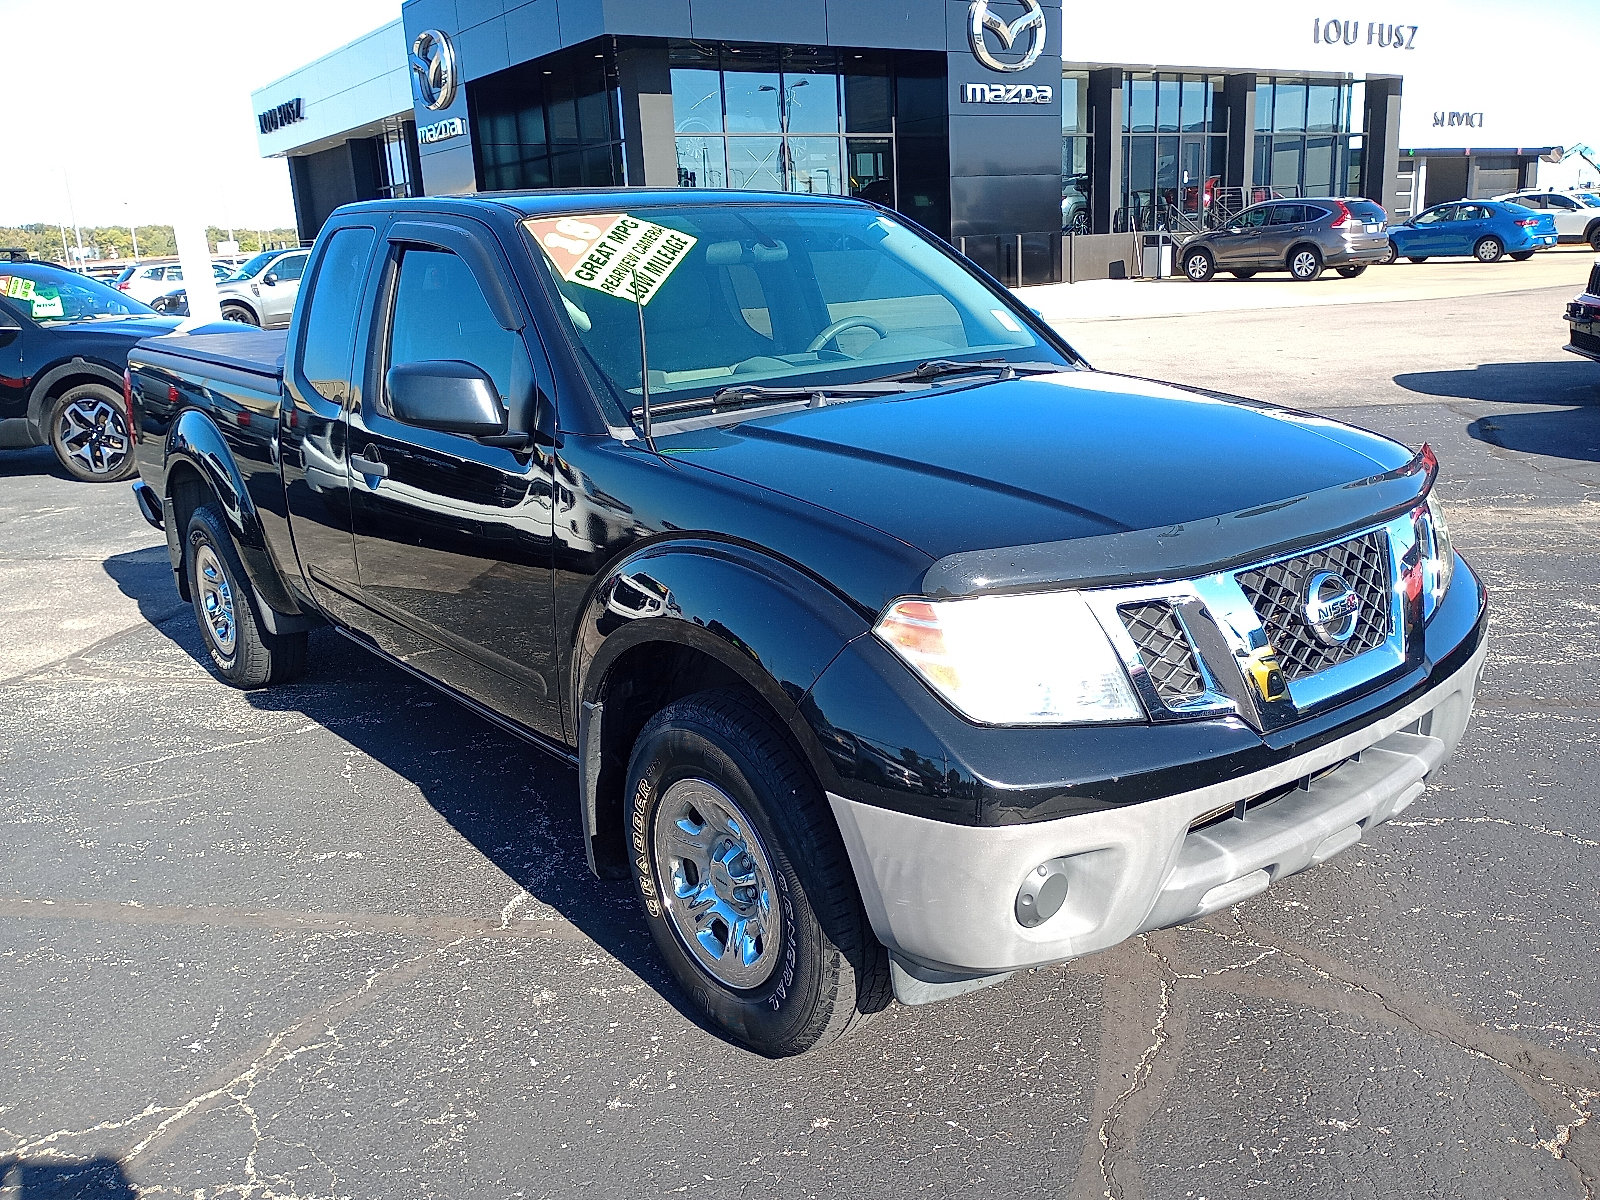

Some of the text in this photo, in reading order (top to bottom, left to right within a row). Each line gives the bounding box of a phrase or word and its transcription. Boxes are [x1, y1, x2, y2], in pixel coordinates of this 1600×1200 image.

[1313, 18, 1419, 50] LOU FUSZ
[965, 82, 1053, 104] mazda
[574, 219, 640, 282] GREAT MPG
[600, 225, 666, 293] REARVIEW CAMERA
[625, 234, 689, 299] LOW MILEAGE
[1318, 592, 1358, 619] NISS
[632, 778, 660, 917] GRABBER
[768, 869, 797, 1011] GENERAL
